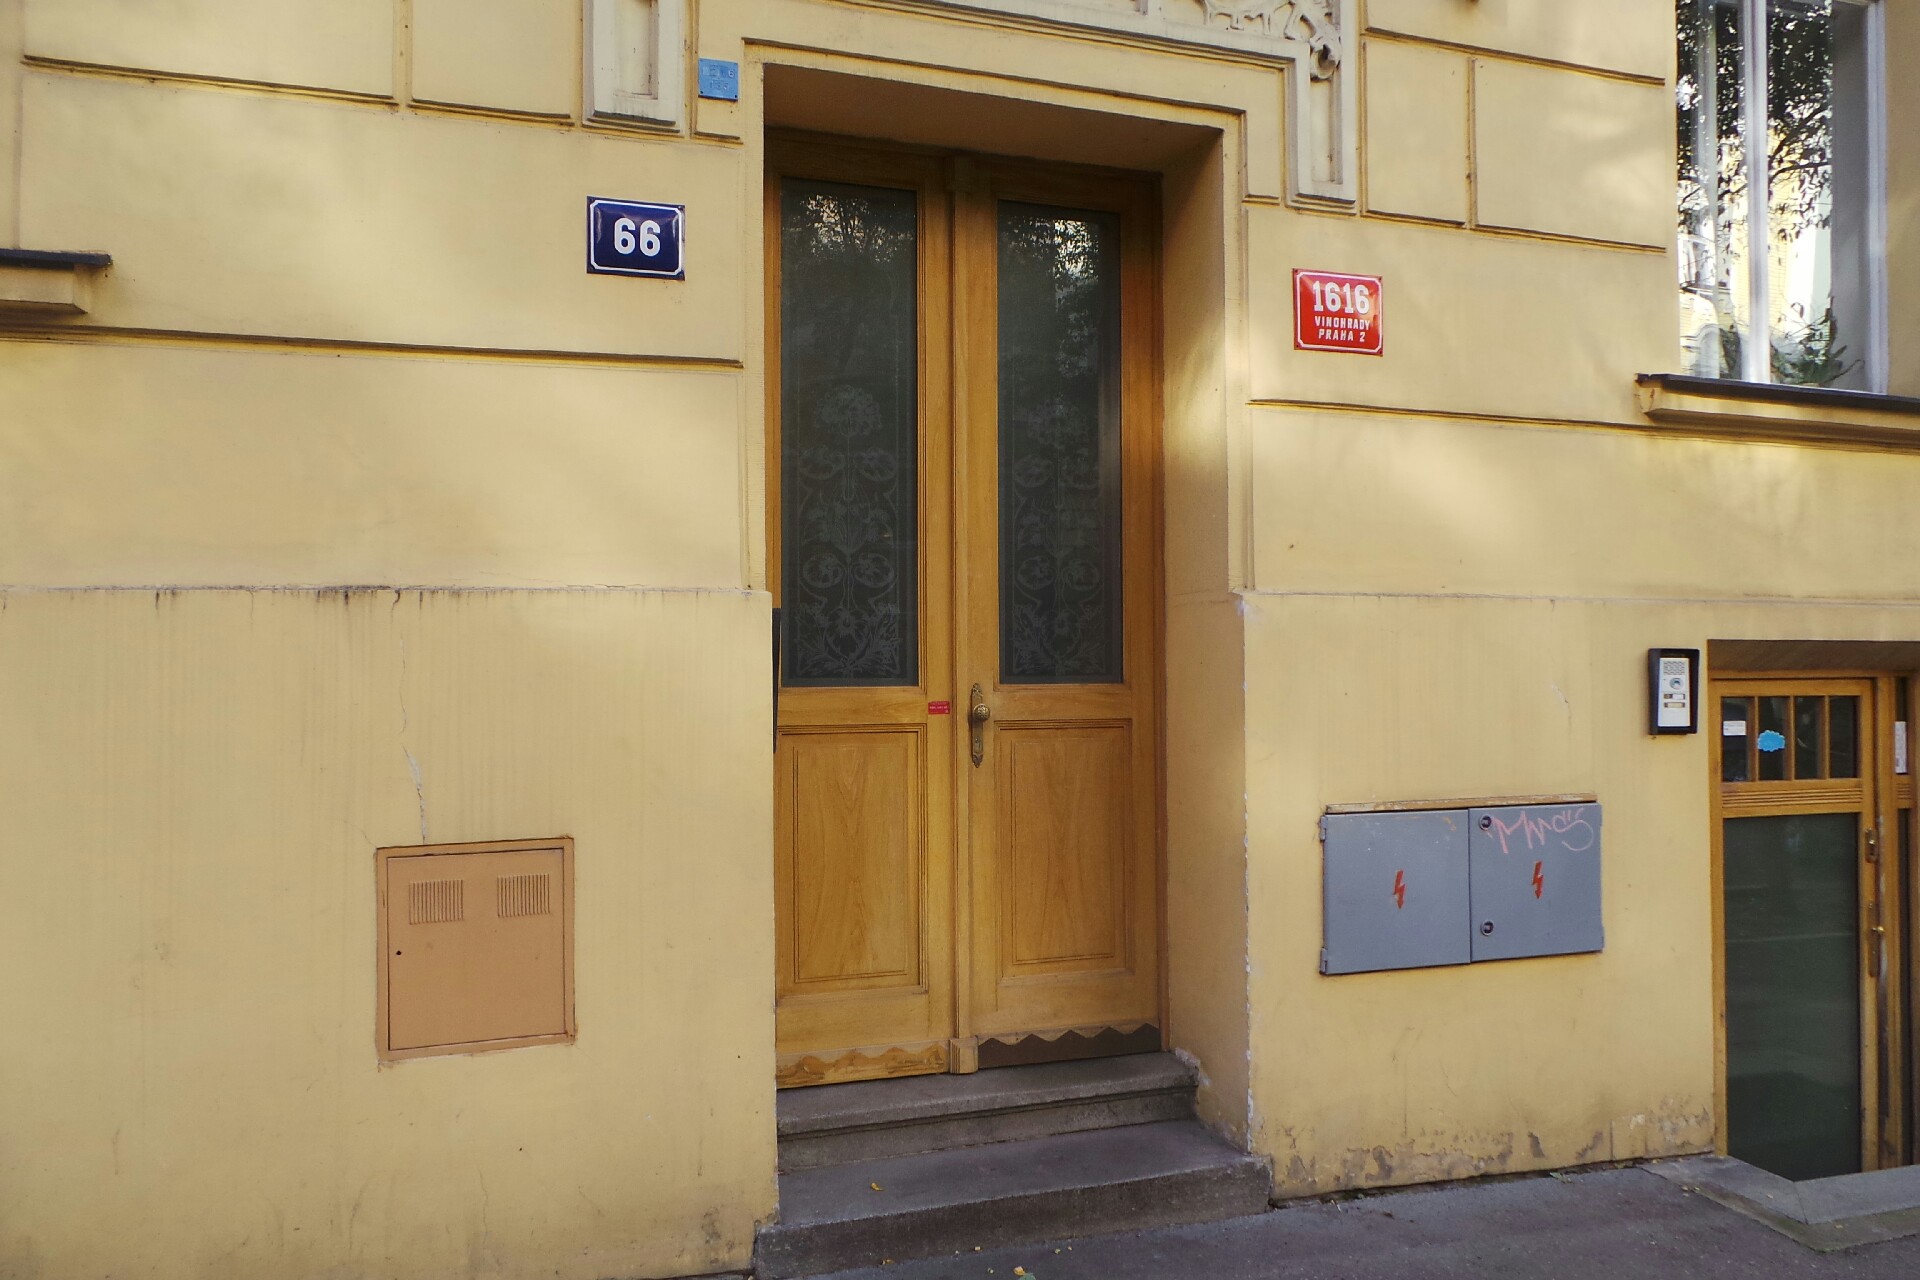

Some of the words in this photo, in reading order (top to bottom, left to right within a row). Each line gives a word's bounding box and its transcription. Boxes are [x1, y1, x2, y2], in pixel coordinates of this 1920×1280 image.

[614, 217, 660, 257] 66
[1312, 280, 1370, 314] 1616
[1314, 315, 1370, 331] VINOHRADY
[1318, 328, 1354, 342] PRAHA
[1359, 331, 1366, 343] 2
